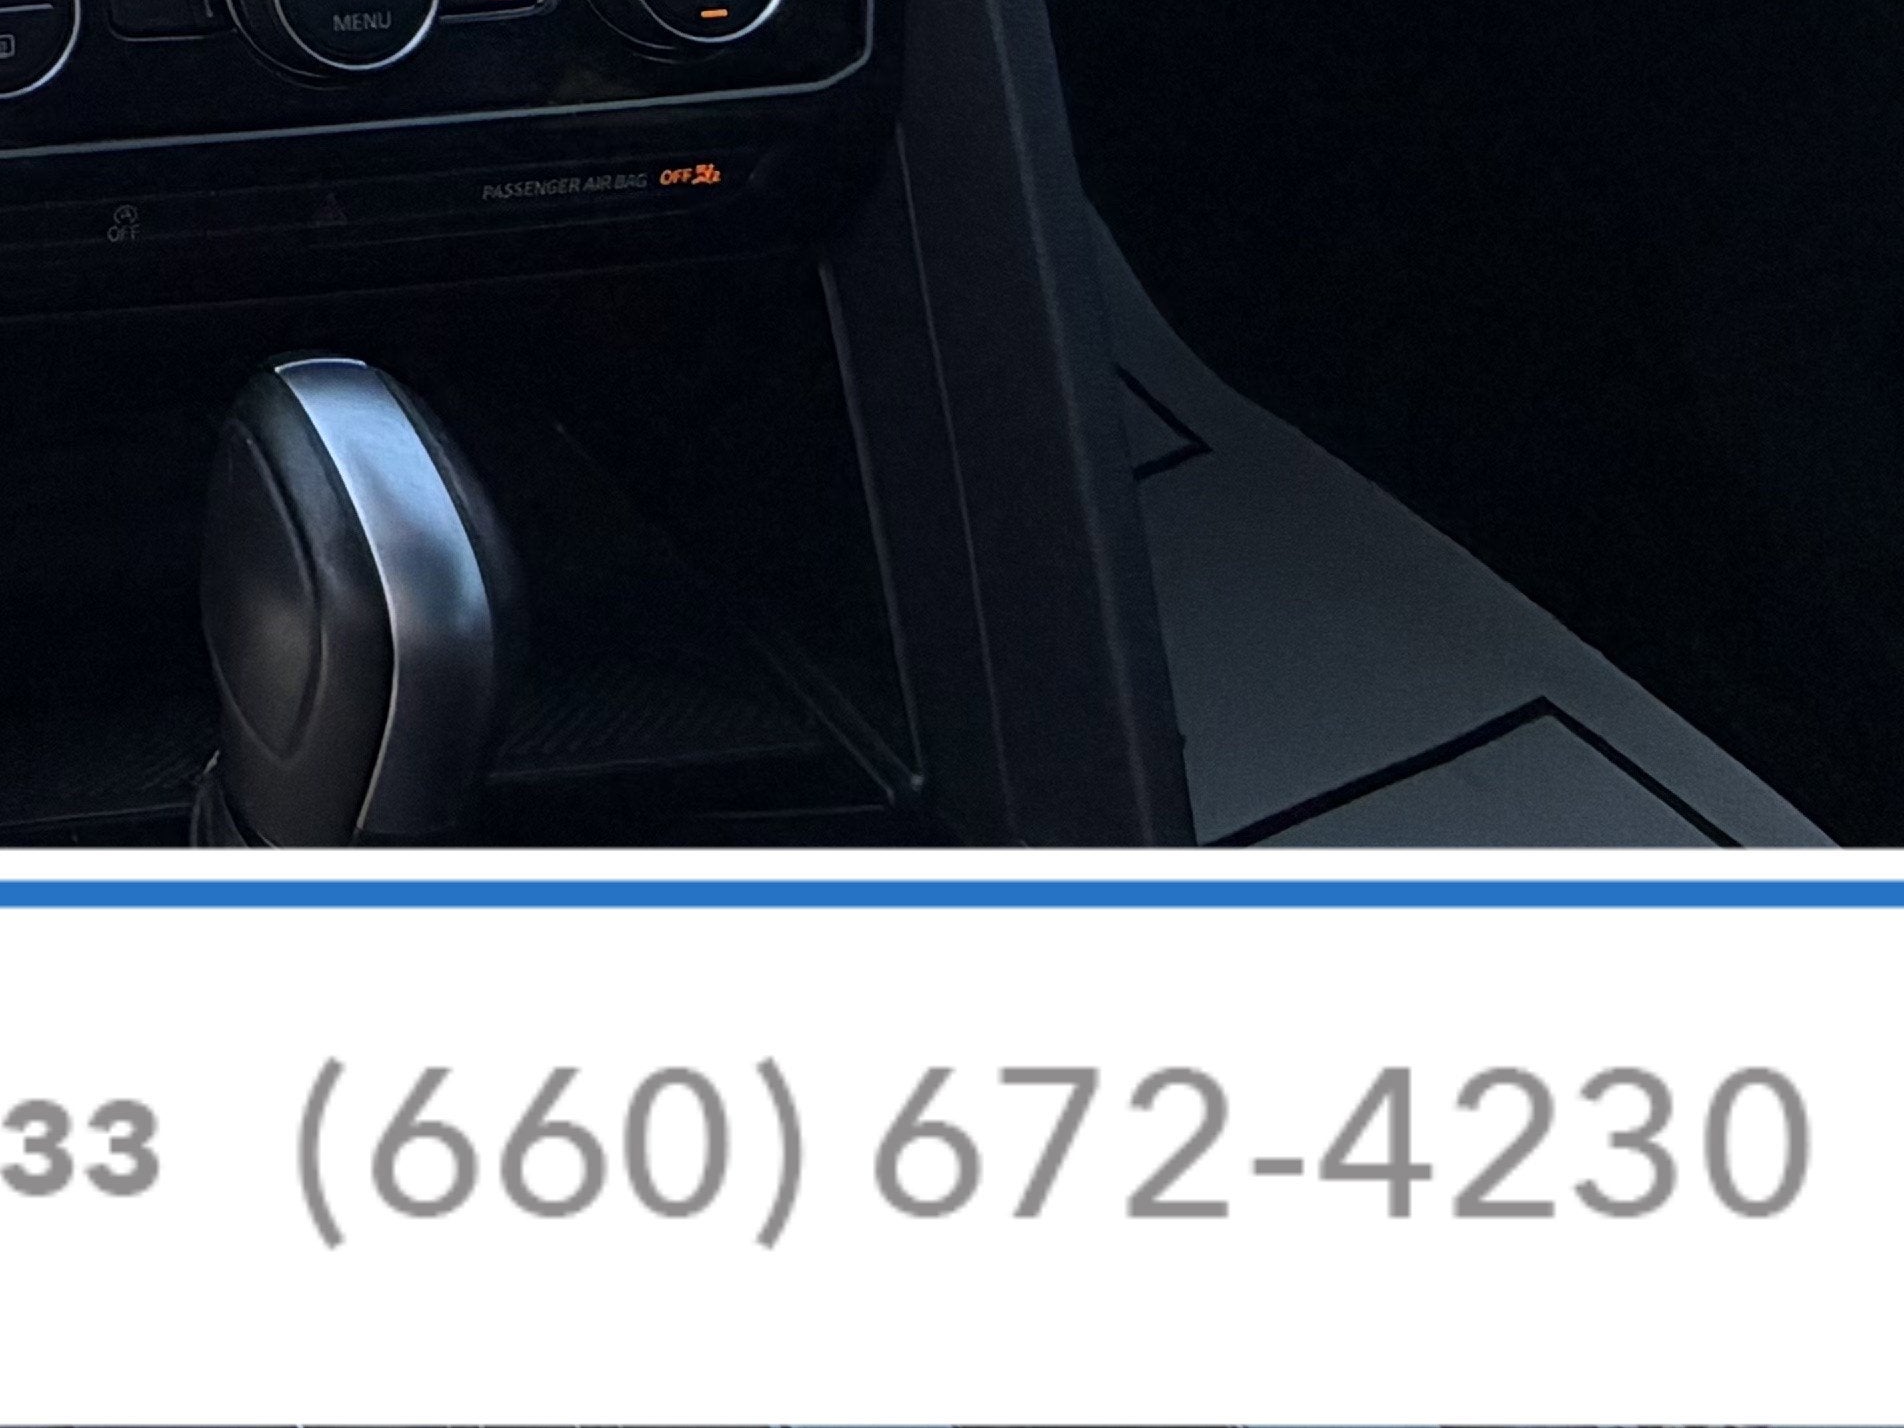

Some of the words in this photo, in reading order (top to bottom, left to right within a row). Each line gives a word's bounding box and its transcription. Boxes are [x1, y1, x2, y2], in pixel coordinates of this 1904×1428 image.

[332, 10, 392, 34] MENU
[482, 176, 581, 201] PASSENGER
[582, 173, 613, 192] AIR
[614, 172, 649, 190] BAG
[659, 167, 693, 186] OFF
